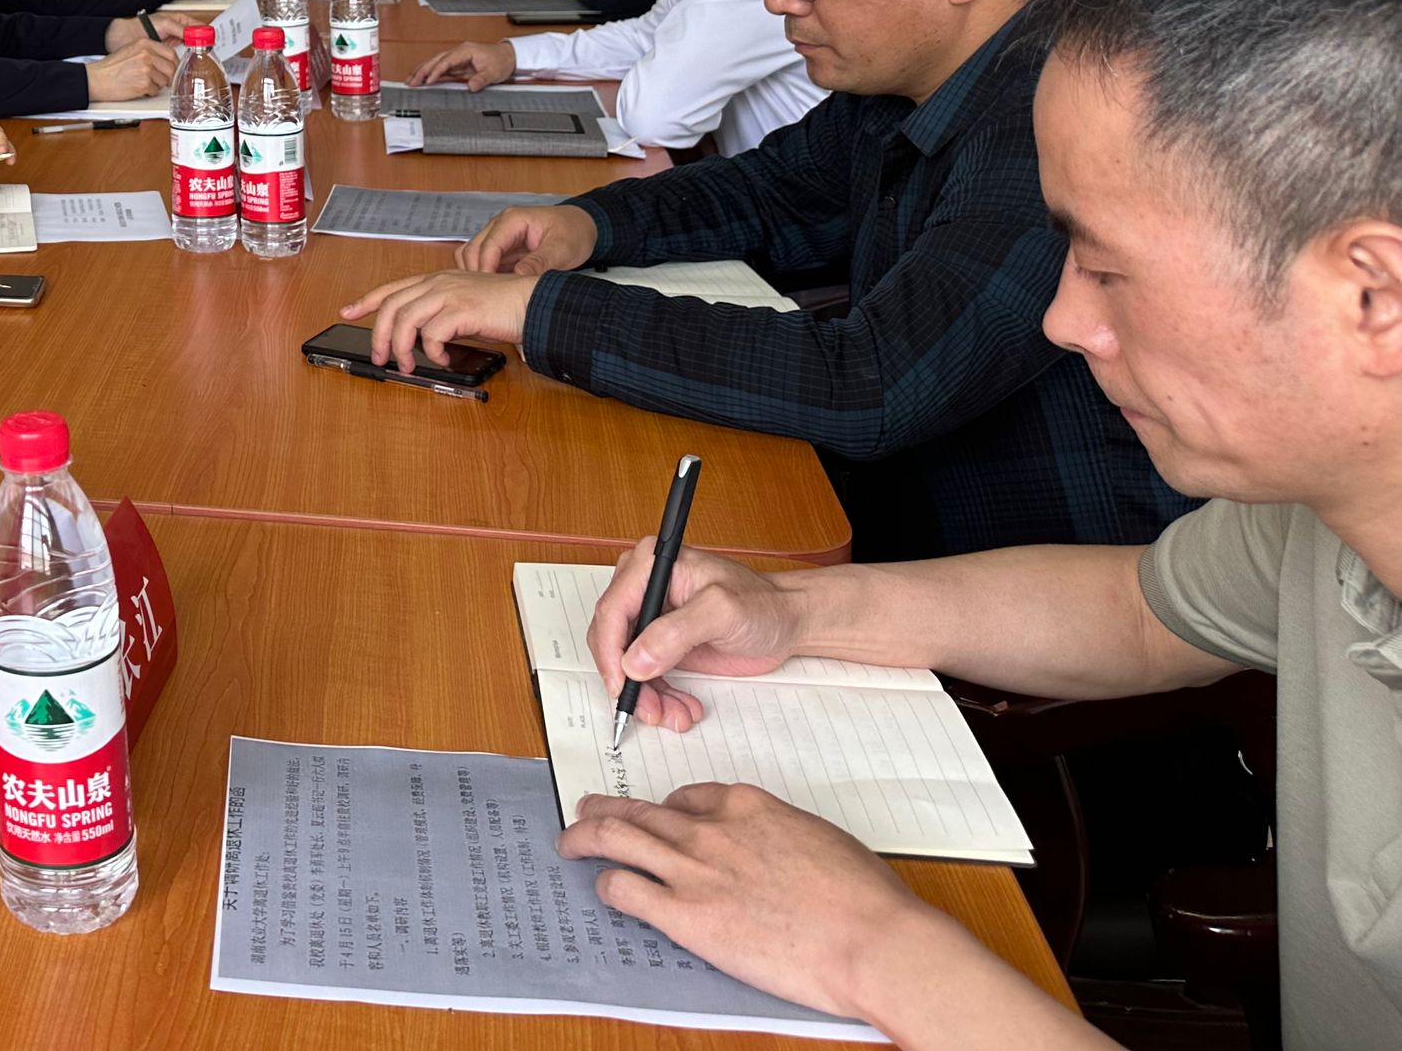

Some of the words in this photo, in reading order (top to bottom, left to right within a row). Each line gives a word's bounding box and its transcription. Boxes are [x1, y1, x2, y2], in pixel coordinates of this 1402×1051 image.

[2, 771, 112, 810] 农夫山泉
[5, 802, 56, 828] NONGFU
[62, 802, 113, 828] SPRING
